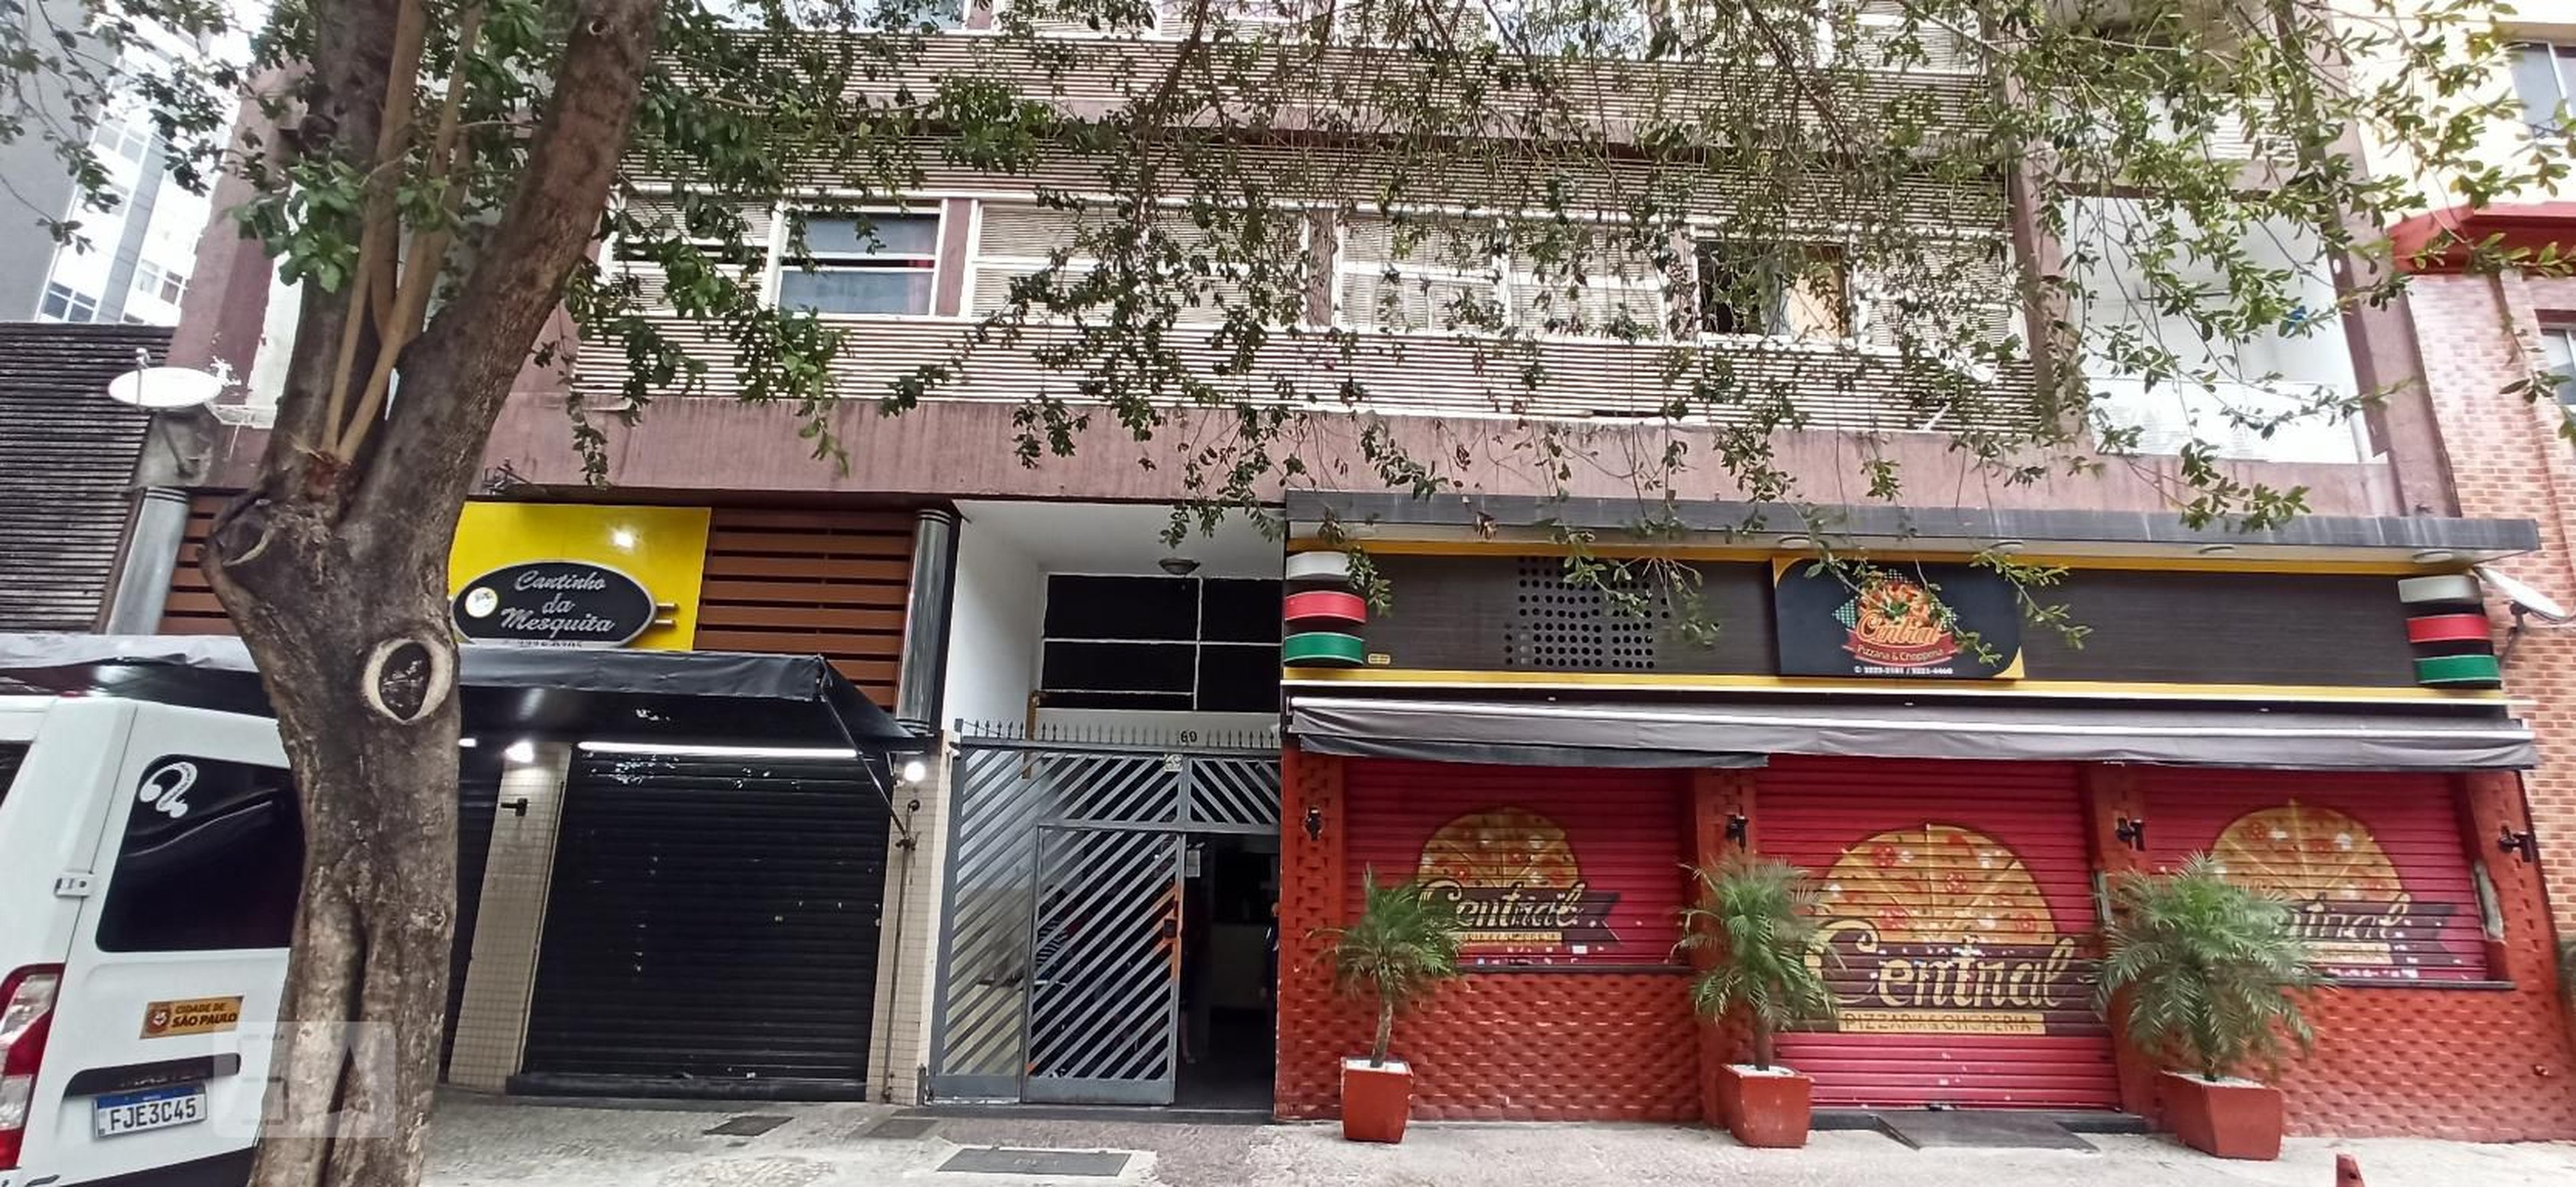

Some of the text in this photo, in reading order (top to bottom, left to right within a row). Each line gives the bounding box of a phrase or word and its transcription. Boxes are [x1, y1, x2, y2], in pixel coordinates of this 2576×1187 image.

[515, 570, 606, 591] Cantinho
[542, 592, 576, 614] da
[500, 606, 615, 638] Mesquita
[1804, 918, 2074, 1007] Central
[175, 1003, 226, 1014] CIDADE DE
[201, 1013, 238, 1025] PAULO
[110, 1097, 197, 1131] FJE3C45
